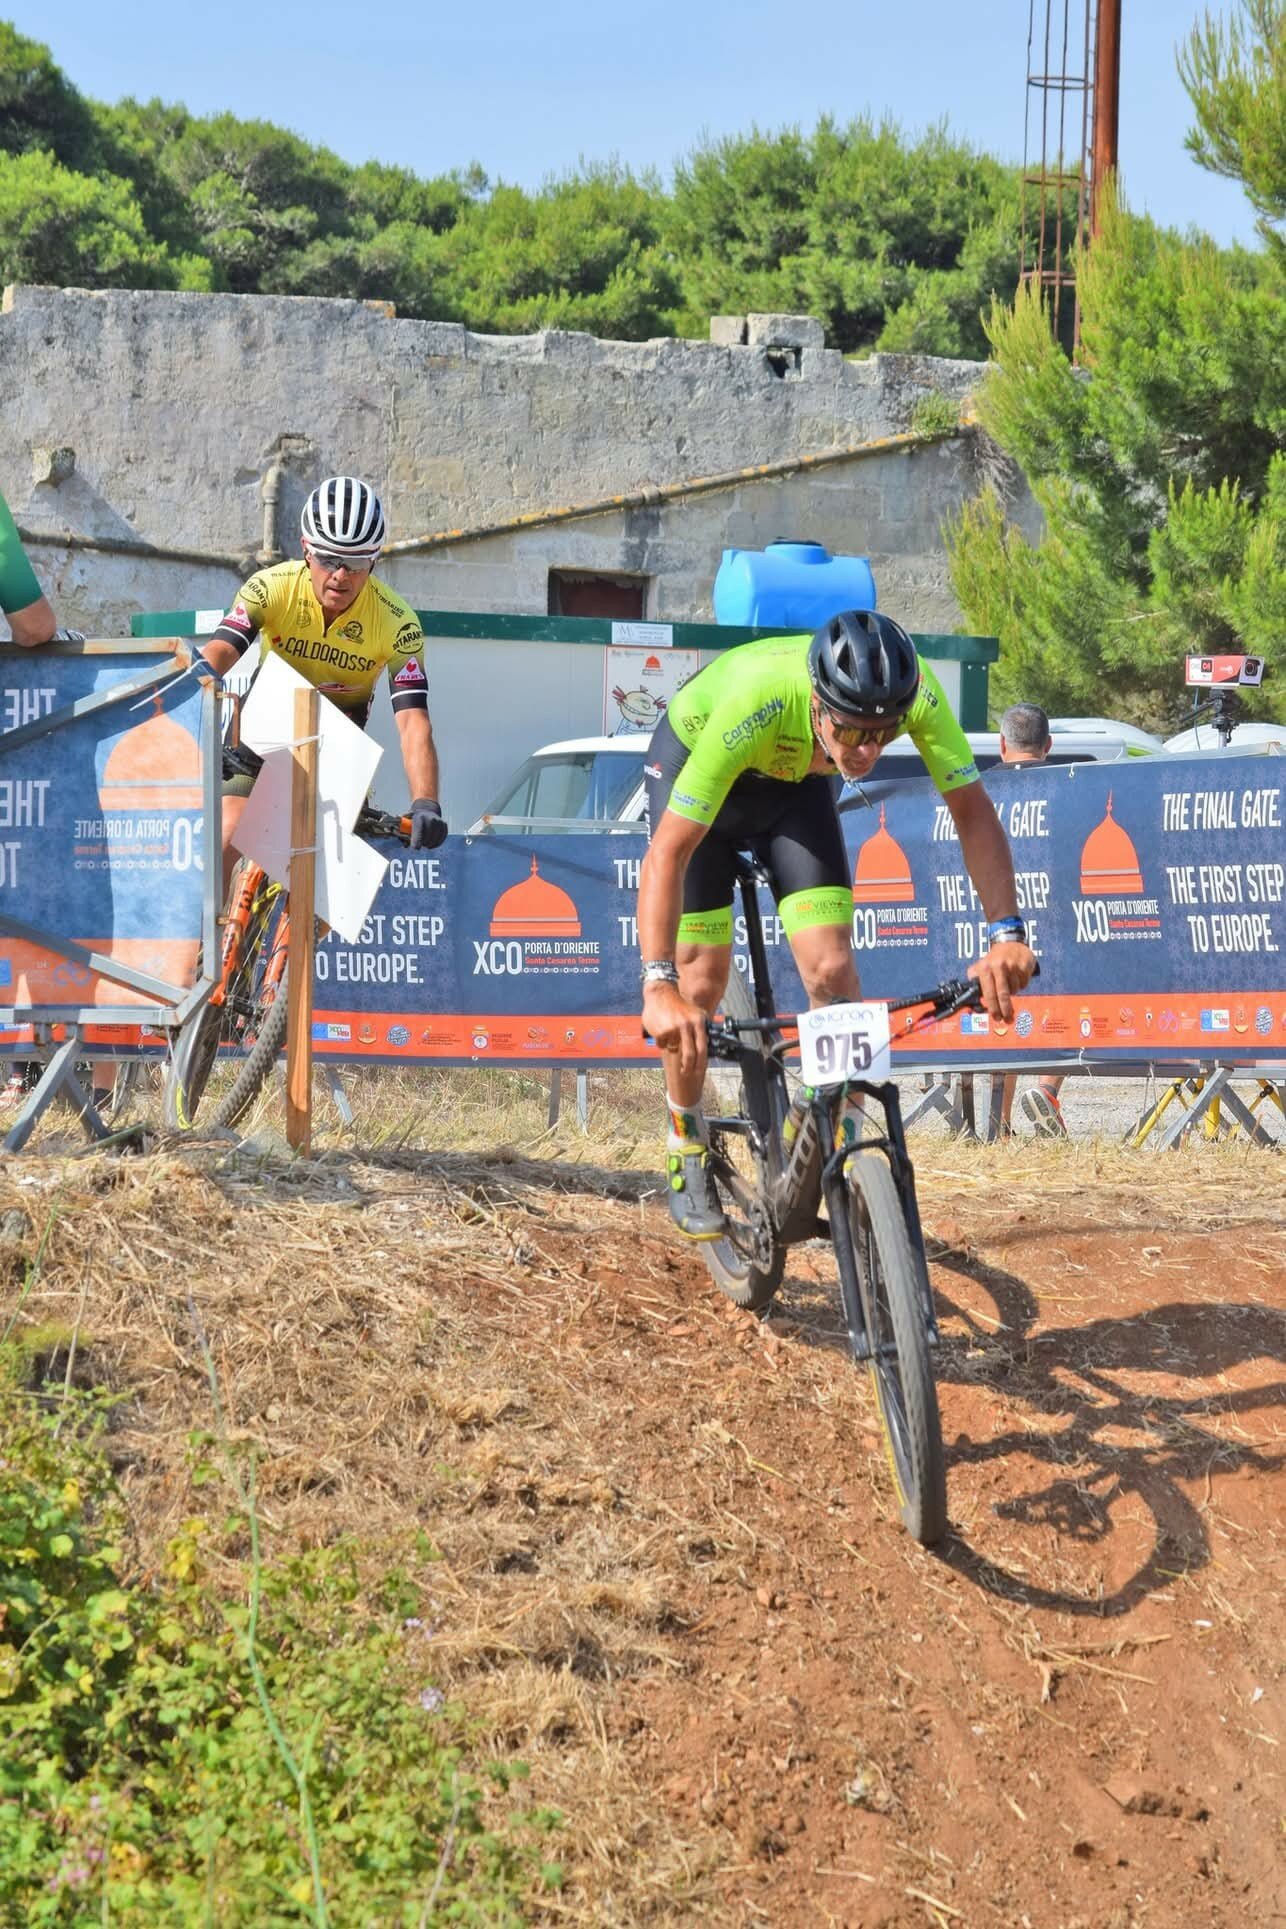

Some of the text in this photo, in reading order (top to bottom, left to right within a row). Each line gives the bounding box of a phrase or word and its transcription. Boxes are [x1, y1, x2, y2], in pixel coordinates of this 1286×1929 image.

[284, 637, 377, 673] CALDOROSSO
[1010, 800, 1049, 837] GATE.
[1163, 789, 1281, 831] THE FINAL GATE.
[390, 859, 446, 889] GATE.
[613, 859, 641, 889] TH
[1014, 871, 1050, 909] STEP
[1166, 863, 1284, 905] THE FIRST STEP
[937, 875, 967, 912] THE
[392, 915, 444, 946] STEP
[734, 915, 786, 945] SEP
[850, 908, 876, 950] CO
[1071, 900, 1110, 943] XCO
[1187, 913, 1279, 953] TO EUROPE.
[473, 941, 523, 975] XCO
[525, 942, 600, 954] PORTA D'ORIENTE
[955, 922, 973, 959] TO
[315, 950, 424, 984] O EUROPE.
[816, 1031, 872, 1075] 975
